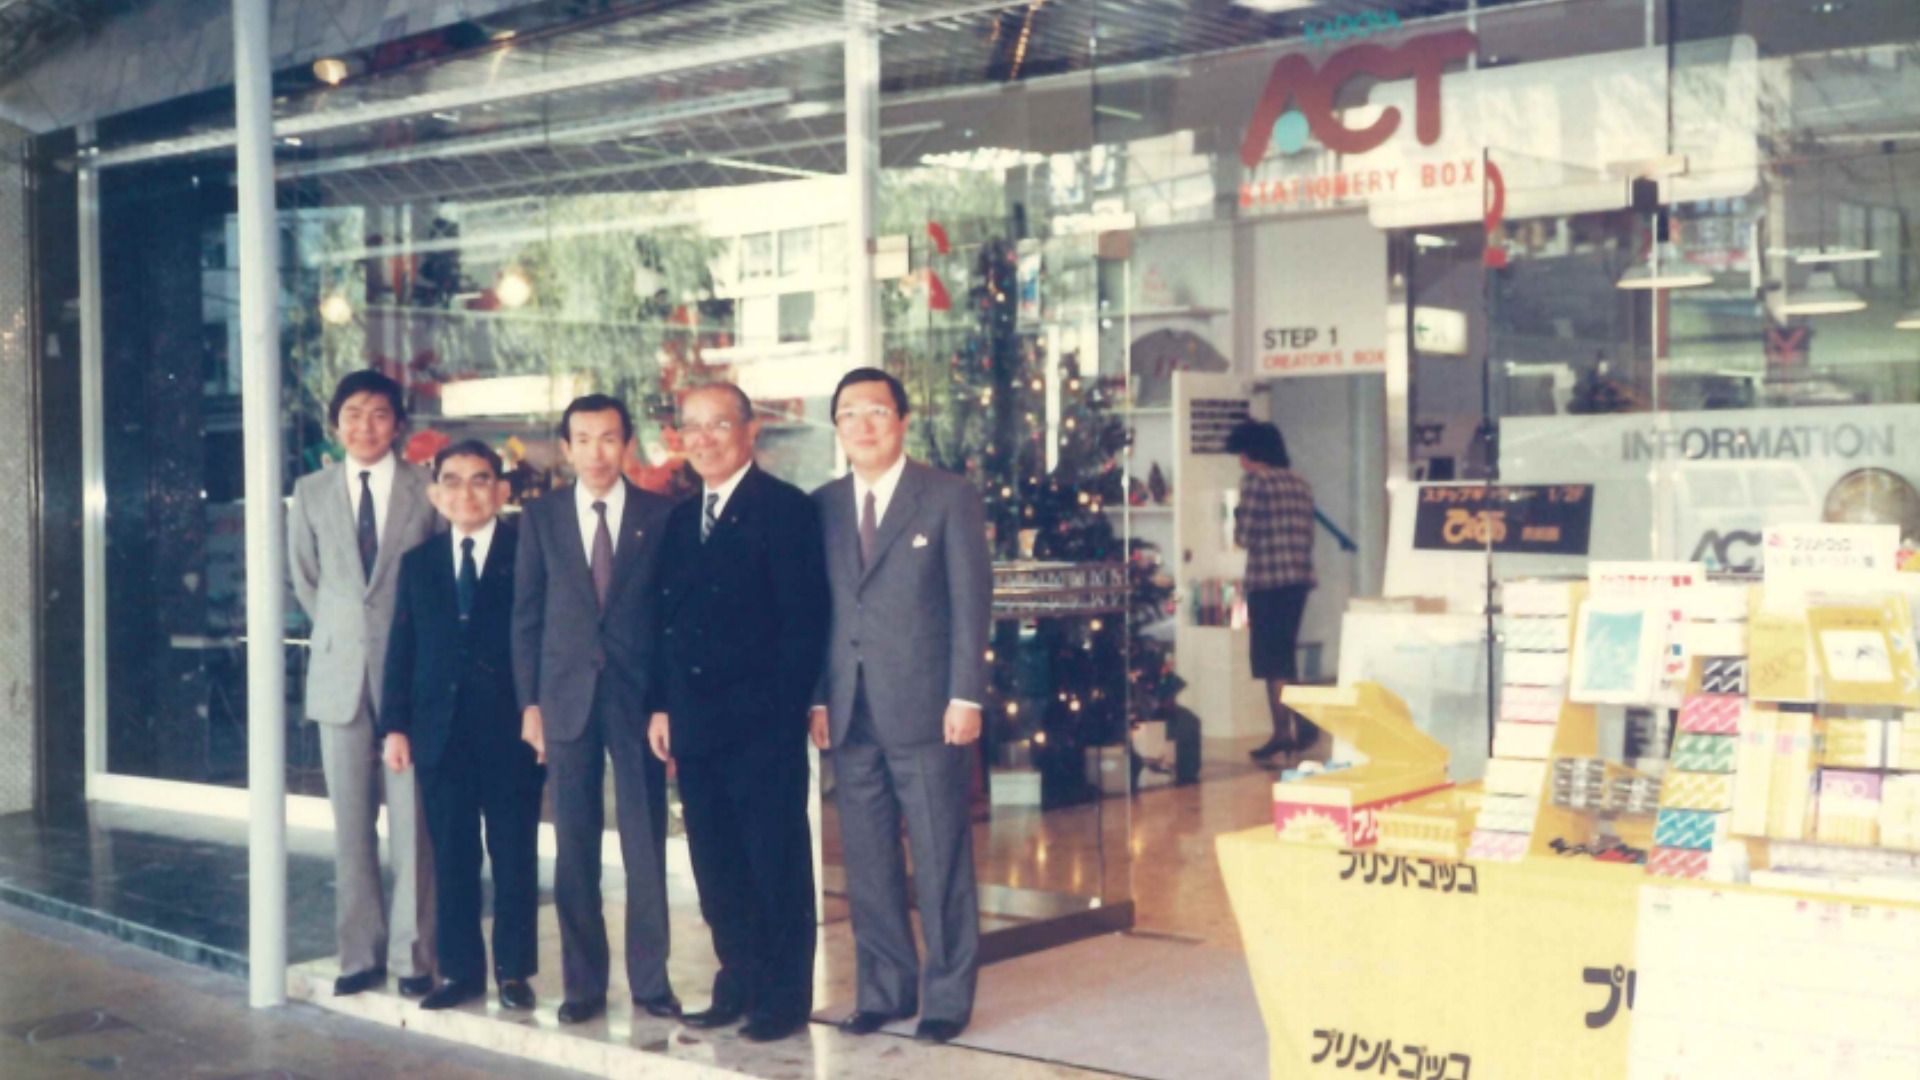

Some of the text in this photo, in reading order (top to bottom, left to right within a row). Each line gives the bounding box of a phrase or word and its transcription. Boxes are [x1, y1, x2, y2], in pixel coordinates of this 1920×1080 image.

[1241, 28, 1479, 168] ACT
[1239, 160, 1475, 208] STATIONERY BOX
[1264, 327, 1338, 349] STEP 1
[1621, 424, 1895, 460] INFORMATION
